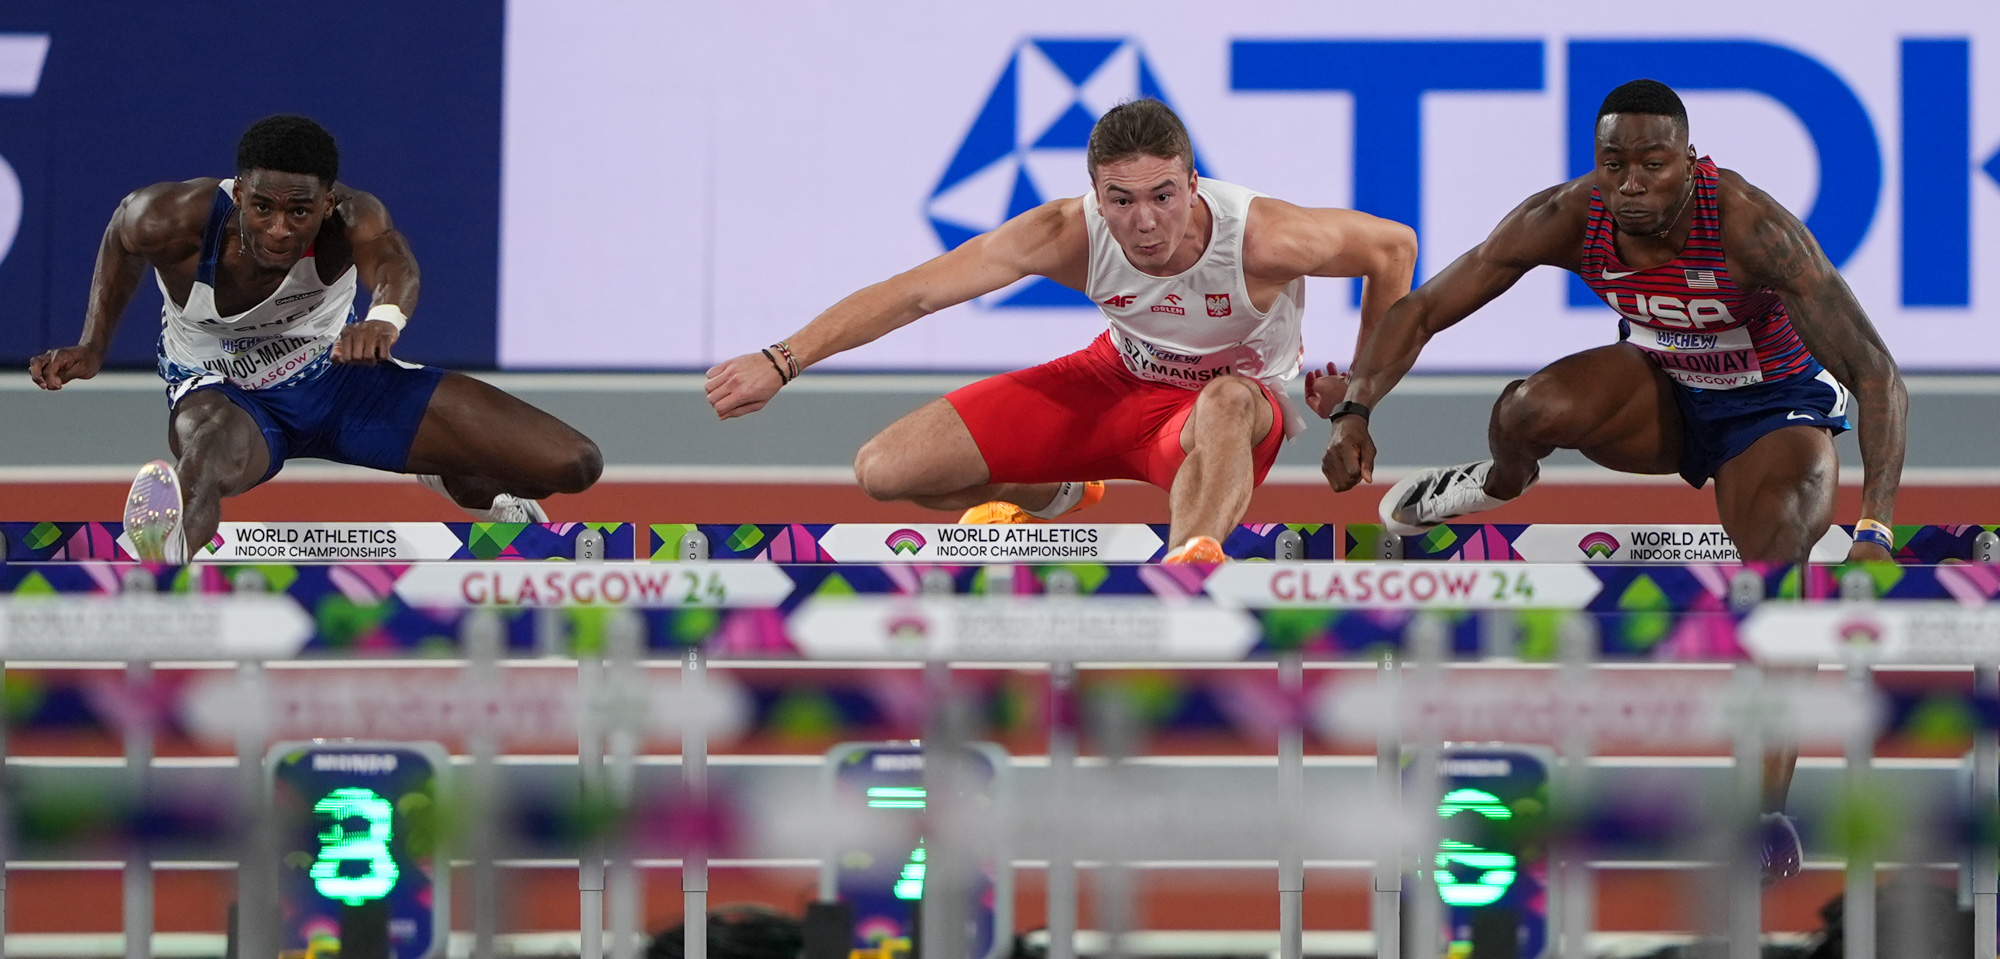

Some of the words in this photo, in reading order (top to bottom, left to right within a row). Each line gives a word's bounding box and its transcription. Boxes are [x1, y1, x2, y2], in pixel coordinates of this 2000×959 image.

[1152, 305, 1183, 315] ORLEN
[1606, 292, 1736, 329] USA
[1656, 330, 1718, 350] HI-CHEW
[203, 336, 318, 379] KWAOU-MATHE
[309, 343, 327, 357] 24
[1124, 337, 1231, 382] SZYMAŃSKI
[1646, 350, 1750, 373] OLLOWAY
[1669, 372, 1738, 385] GLASGOW
[1741, 375, 1758, 385] 24
[236, 528, 299, 543] WORLD
[302, 529, 397, 544] ATHLETICS
[937, 528, 1000, 543] WORLD
[1004, 528, 1099, 543] ATHLETICS
[1630, 531, 1694, 546] WORLD
[235, 545, 286, 557] INDOOR
[288, 546, 397, 558] CHAMPIONSHIPS
[937, 545, 988, 557] INDOOR
[990, 545, 1098, 557] CHAMPIONSHIPS
[1630, 549, 1681, 560] INDOOR
[461, 571, 670, 605] GLASGOW
[682, 570, 728, 605] 24
[1269, 569, 1479, 602] GLASGOW
[1488, 570, 1537, 601] 24
